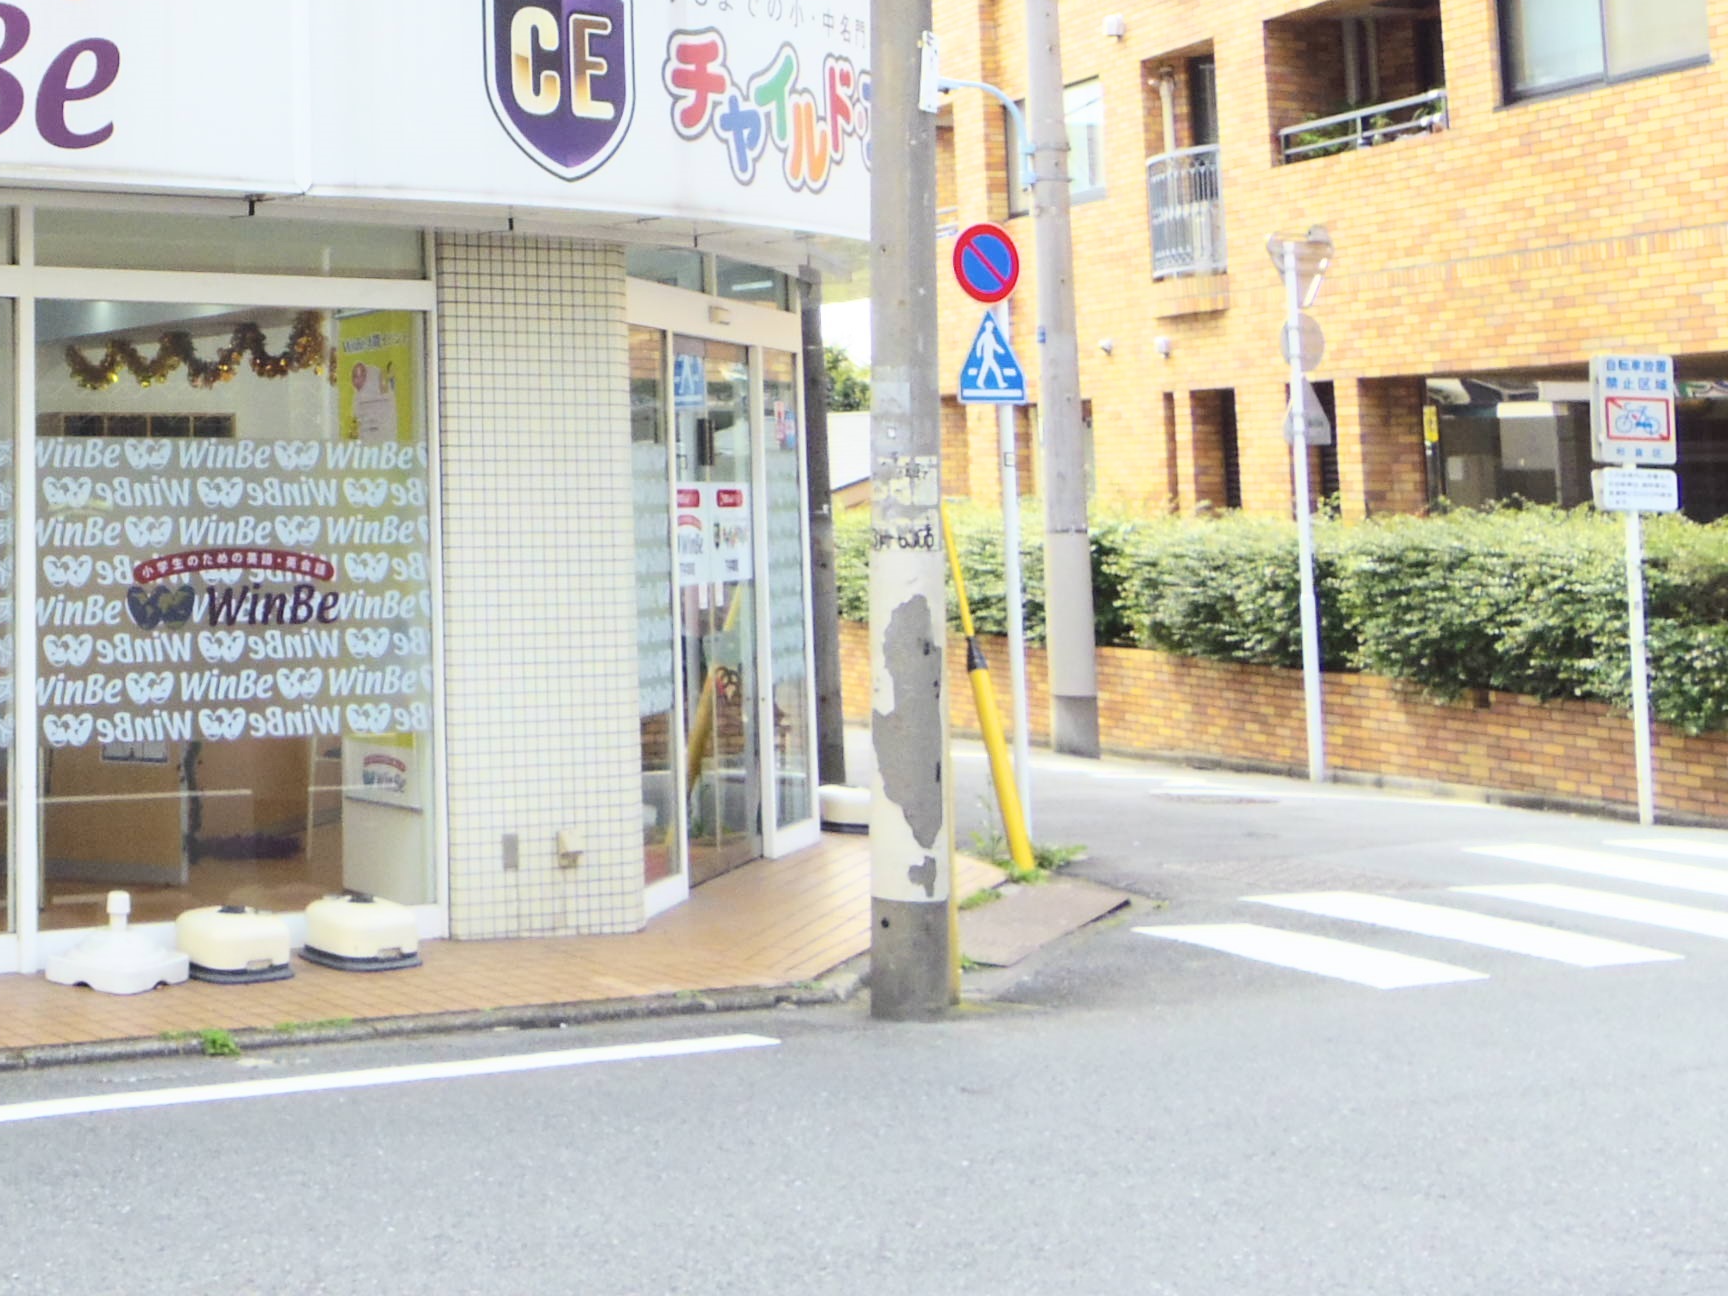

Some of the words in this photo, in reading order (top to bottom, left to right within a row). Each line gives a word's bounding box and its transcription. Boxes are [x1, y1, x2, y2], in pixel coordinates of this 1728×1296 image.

[510, 6, 615, 120] CE
[663, 27, 871, 194] チャイルド・
[179, 438, 271, 469] WinBe
[326, 439, 414, 469] WinBe
[179, 514, 271, 545] WinBe
[327, 514, 414, 544] WinBe
[206, 583, 339, 626] WinBe
[180, 668, 273, 701] WinBe
[329, 665, 417, 696] WinBe
